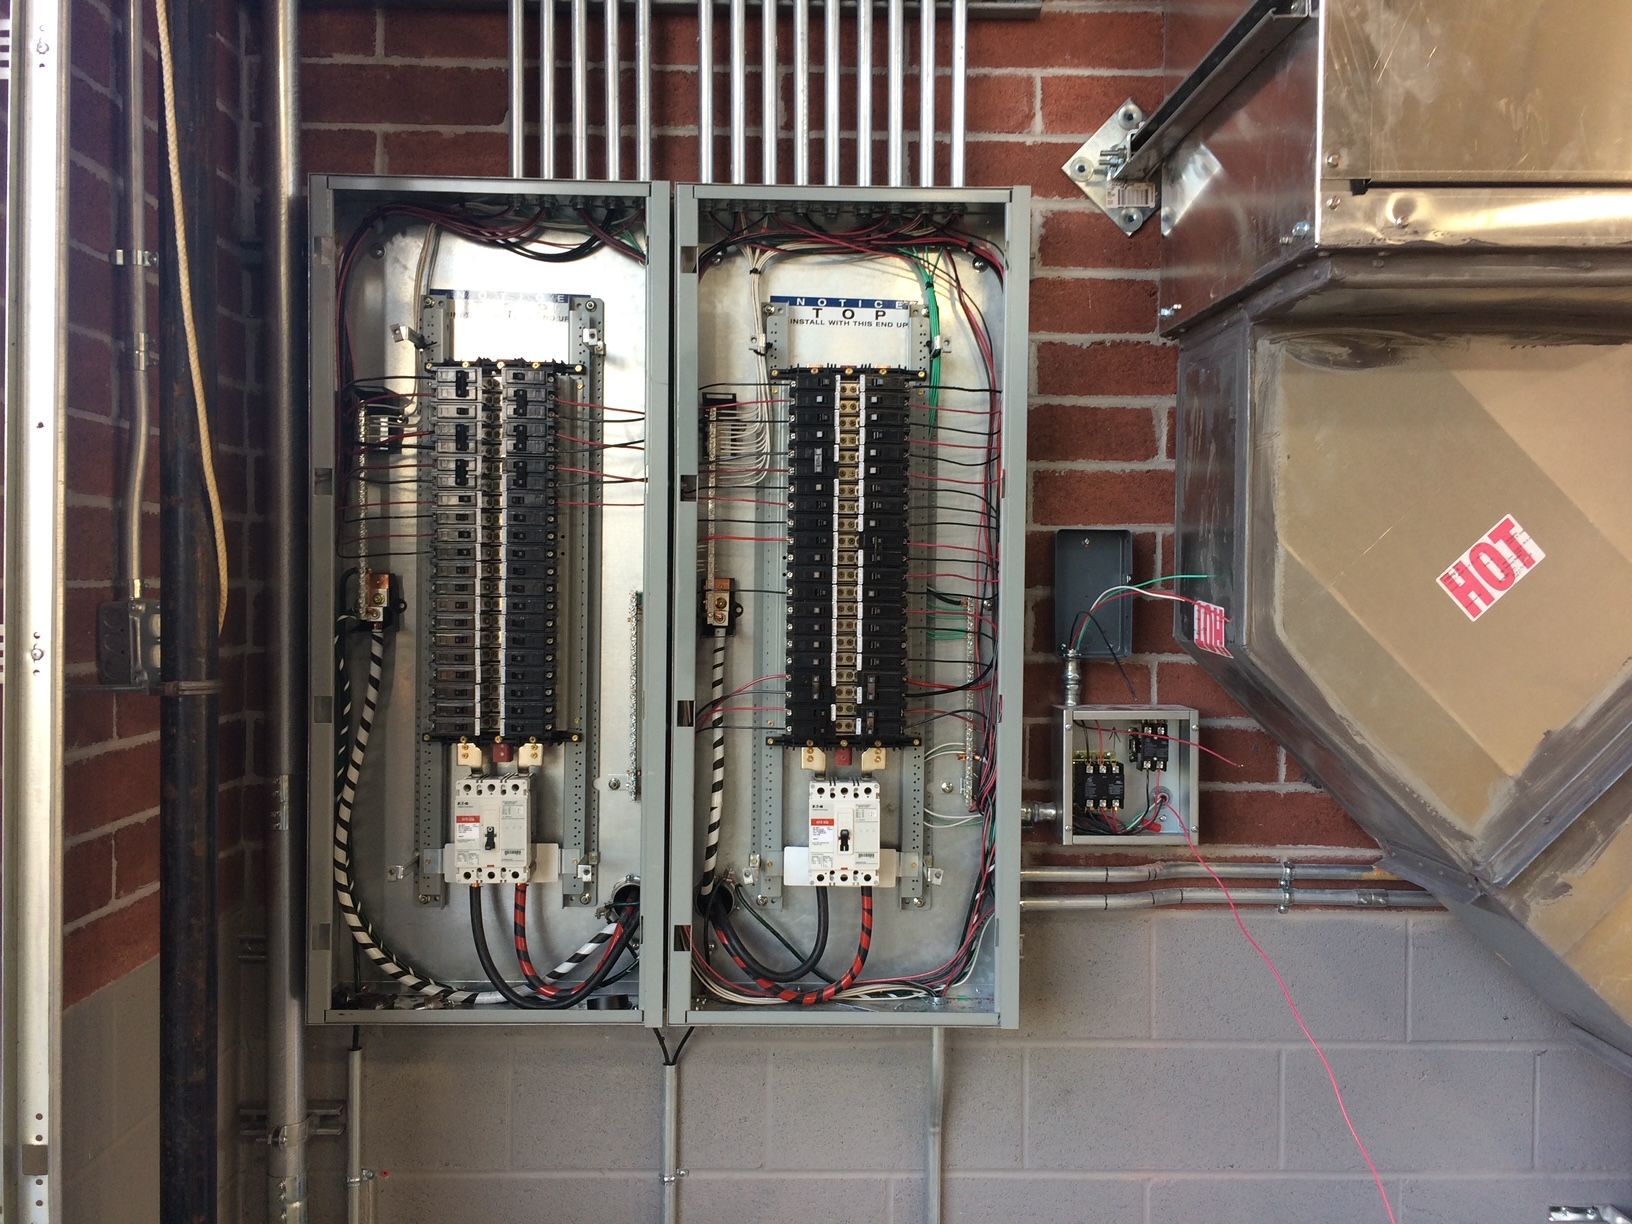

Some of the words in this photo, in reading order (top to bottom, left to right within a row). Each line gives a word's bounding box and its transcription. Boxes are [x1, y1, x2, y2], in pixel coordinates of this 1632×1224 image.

[796, 297, 903, 309] NOTICE
[812, 307, 886, 320] TOP
[790, 318, 825, 326] INSTALL
[1440, 518, 1536, 618] HOT
